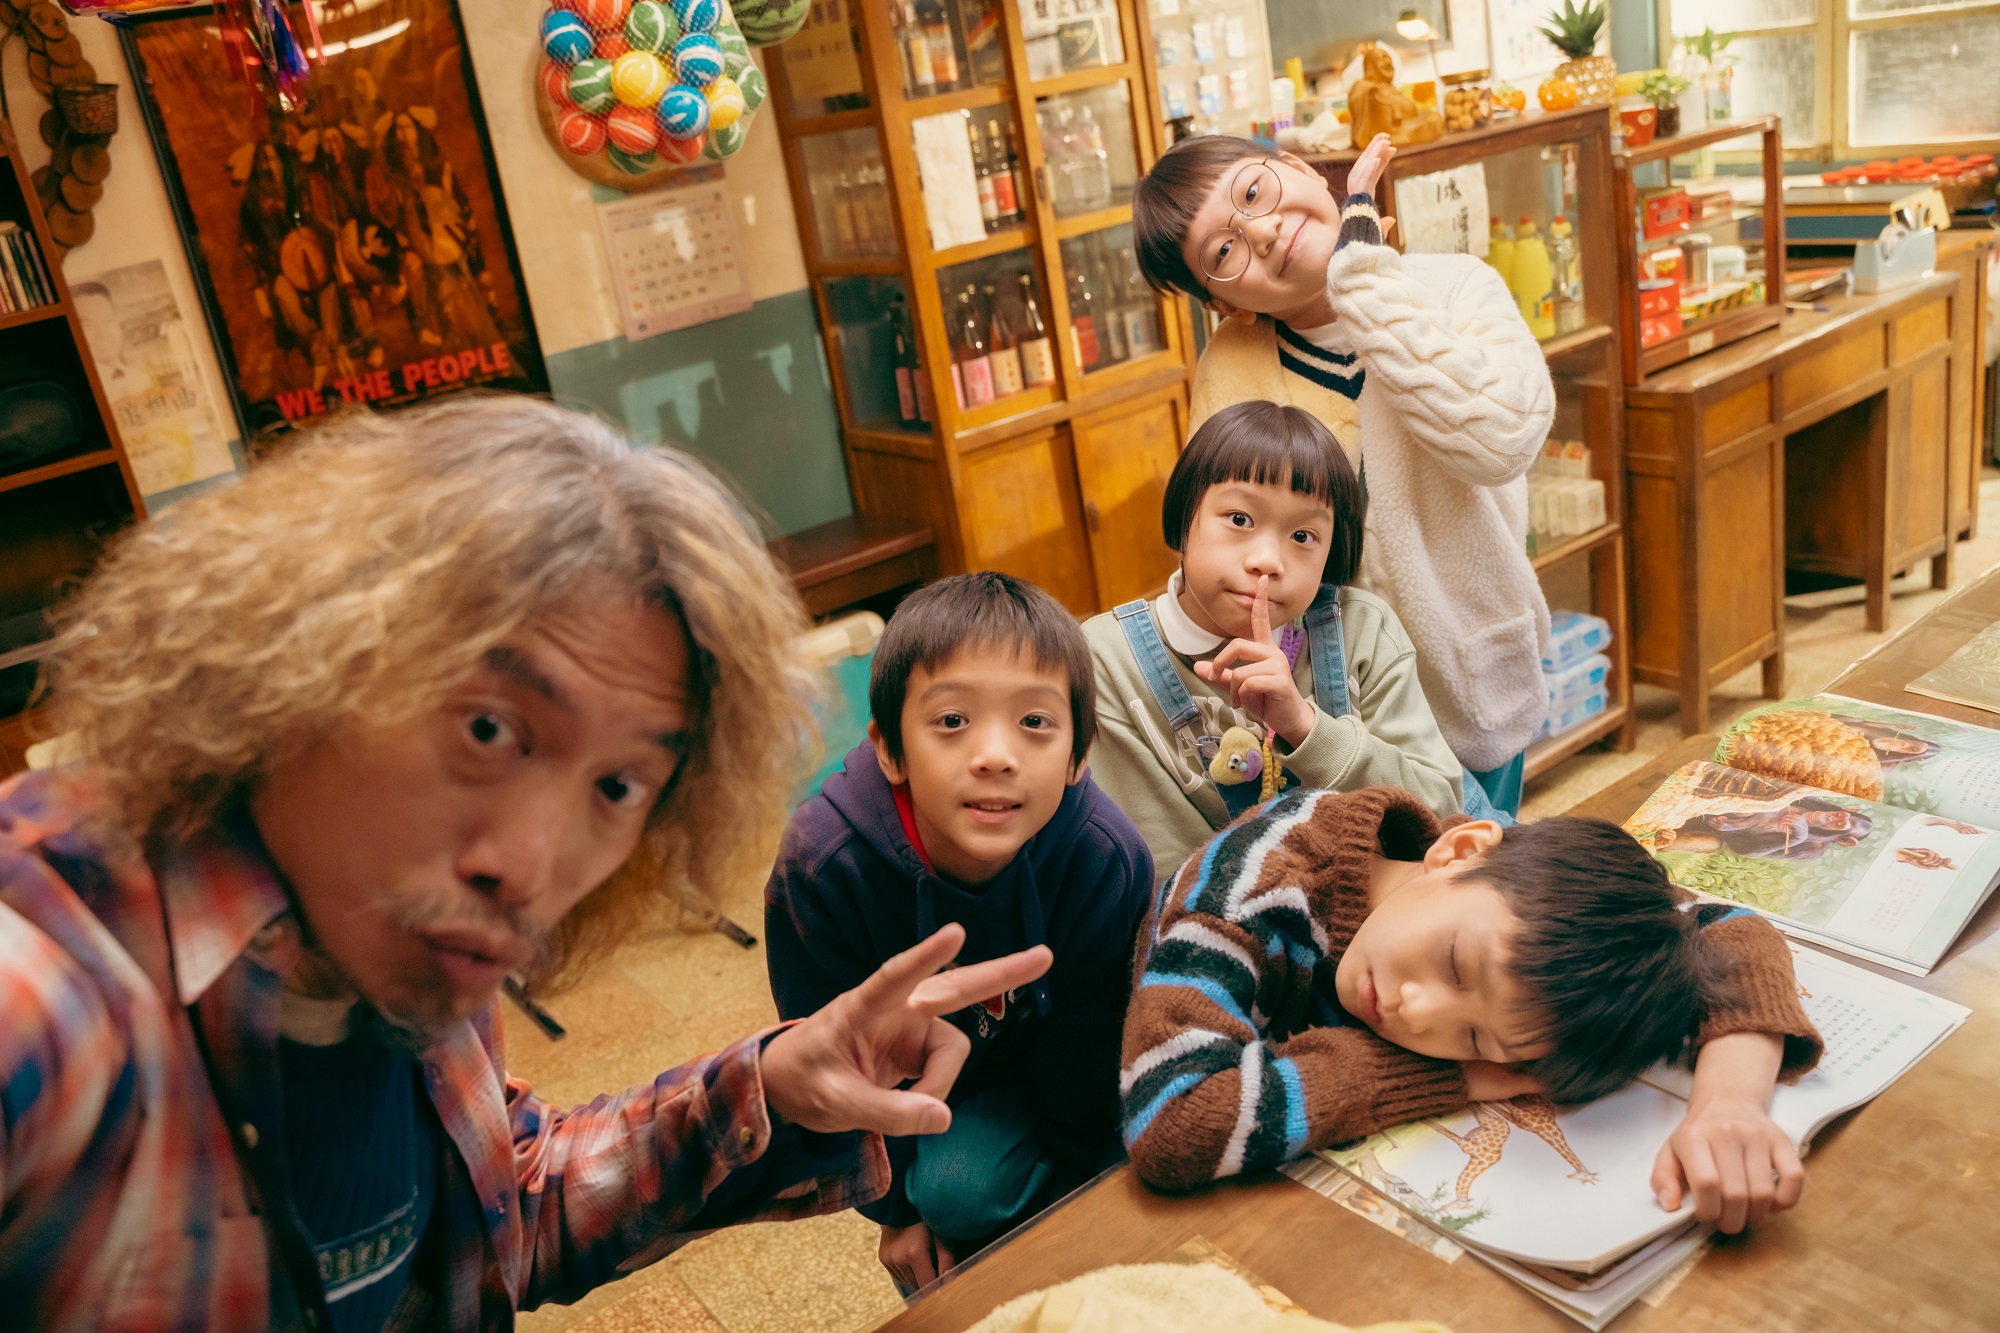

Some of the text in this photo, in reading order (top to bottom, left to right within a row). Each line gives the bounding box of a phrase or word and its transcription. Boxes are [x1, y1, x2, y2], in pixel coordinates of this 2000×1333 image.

[275, 388, 327, 420] WE
[333, 369, 395, 404] THE
[402, 341, 511, 392] PEOPLE
